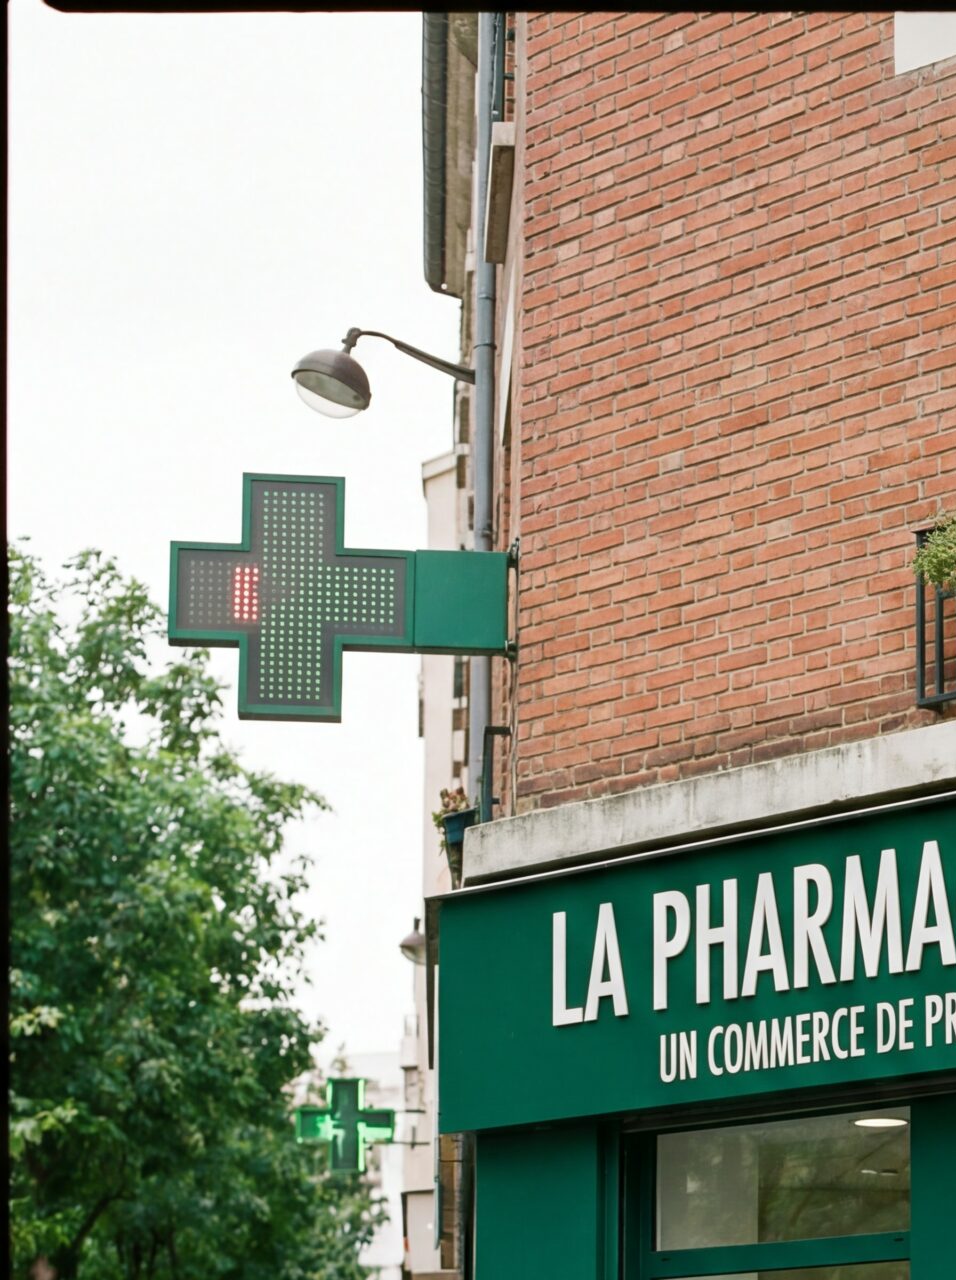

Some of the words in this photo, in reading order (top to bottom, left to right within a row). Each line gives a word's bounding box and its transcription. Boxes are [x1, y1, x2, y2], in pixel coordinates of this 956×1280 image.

[552, 903, 629, 1027] LA
[660, 1030, 697, 1083] UN
[707, 1005, 865, 1076] COMMERCE
[876, 998, 914, 1054] DE
